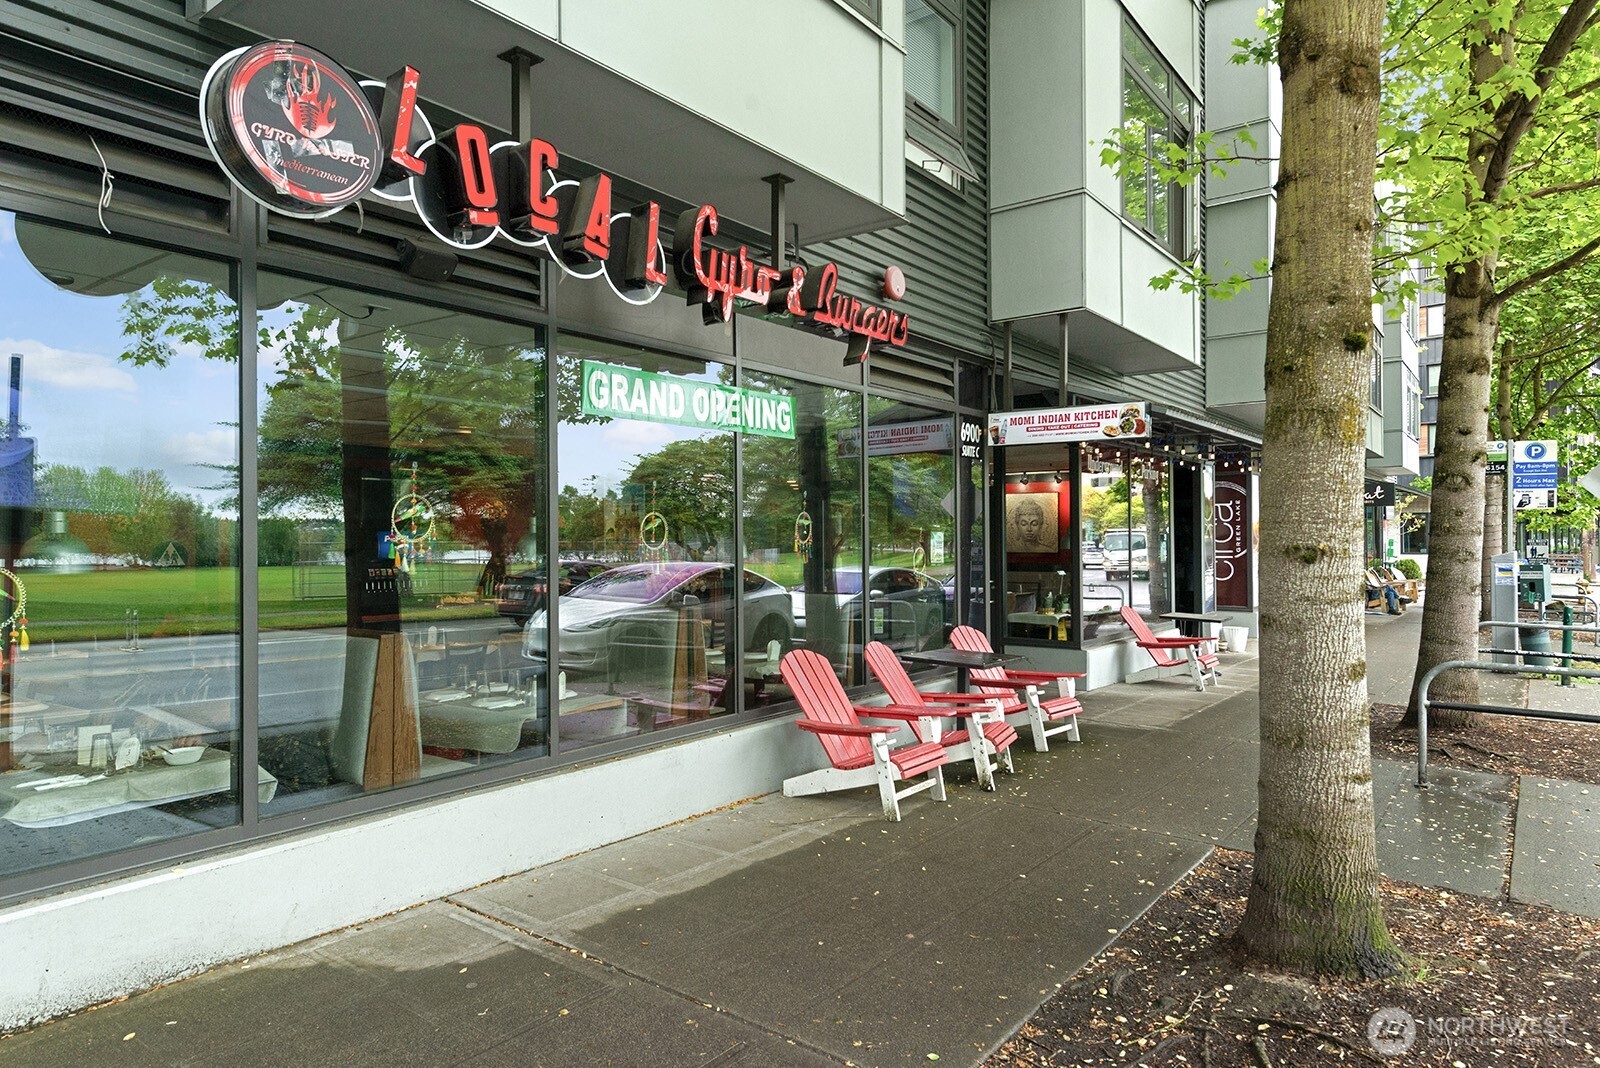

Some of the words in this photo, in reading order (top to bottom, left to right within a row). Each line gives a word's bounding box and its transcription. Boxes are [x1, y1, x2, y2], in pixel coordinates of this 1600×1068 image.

[250, 121, 298, 147] GYRO
[693, 204, 781, 322] Gyro
[786, 265, 808, 317] &
[812, 262, 909, 364] Burgers
[587, 369, 686, 420] GRAND
[691, 386, 793, 434] OPENING
[1009, 415, 1035, 427] MOMI
[1037, 412, 1071, 425] INDIAN
[1073, 409, 1119, 422] KITCHEN
[960, 421, 980, 444] 6900
[961, 444, 976, 458] SUITE
[1515, 476, 1522, 484] 2
